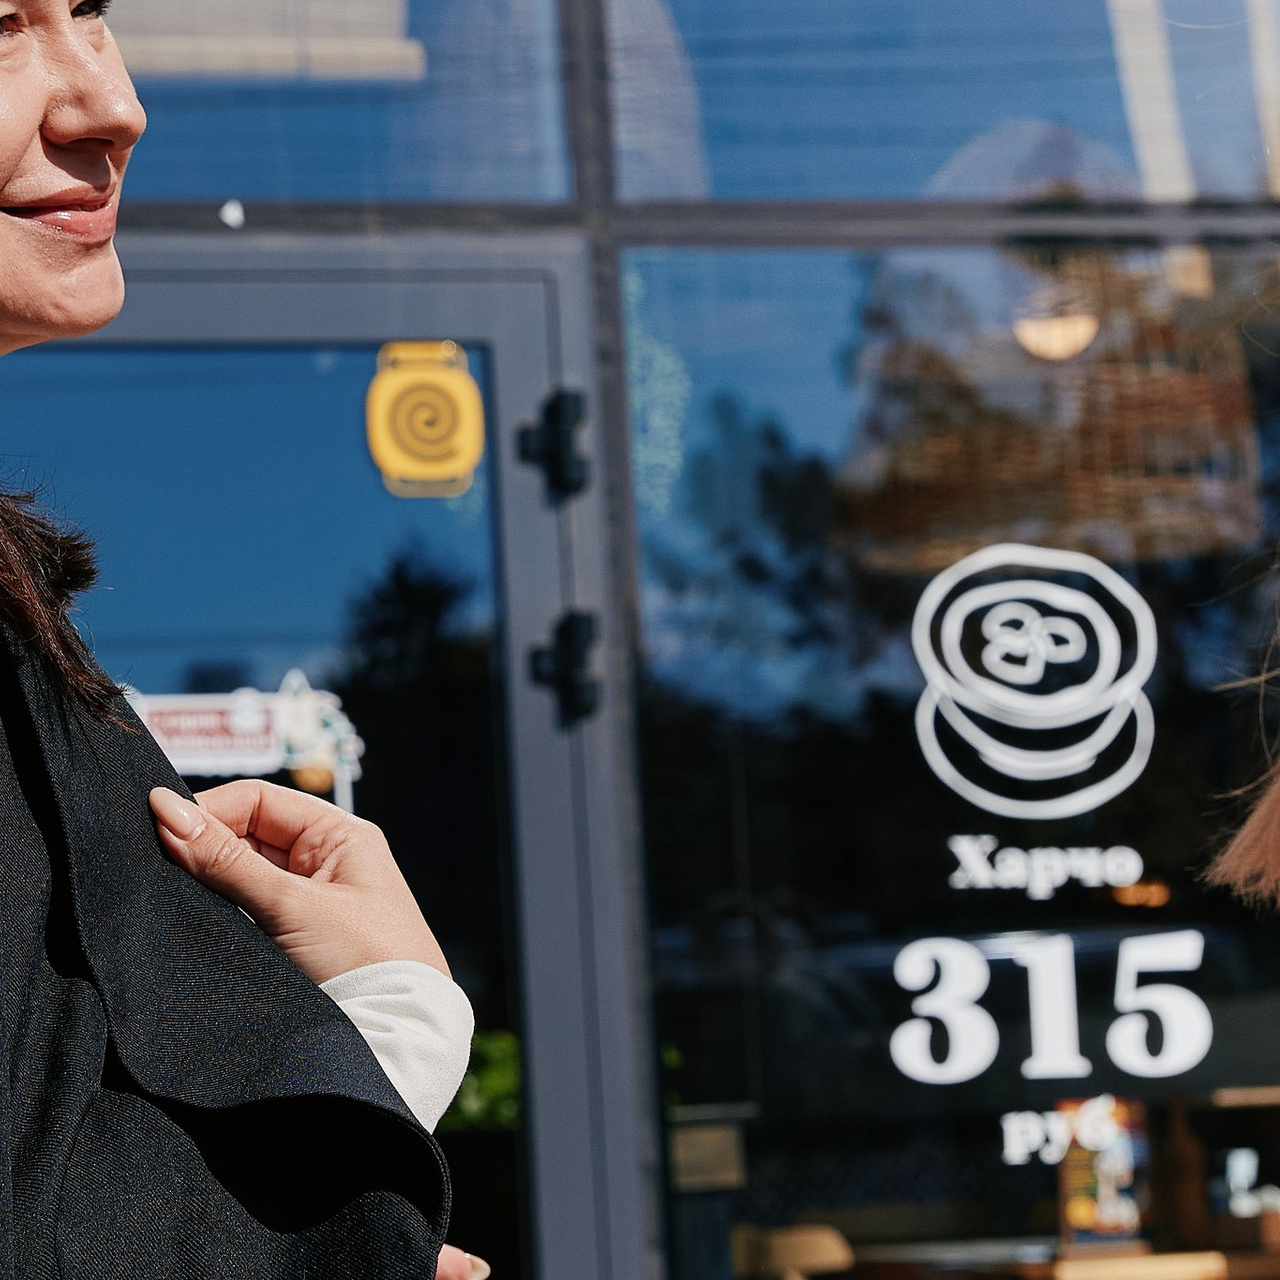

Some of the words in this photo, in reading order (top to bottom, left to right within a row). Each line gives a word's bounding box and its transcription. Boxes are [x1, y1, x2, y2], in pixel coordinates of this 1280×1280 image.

[946, 832, 1145, 900] Харчо
[889, 929, 1214, 1085] 315
[1001, 1093, 1121, 1166] руб
